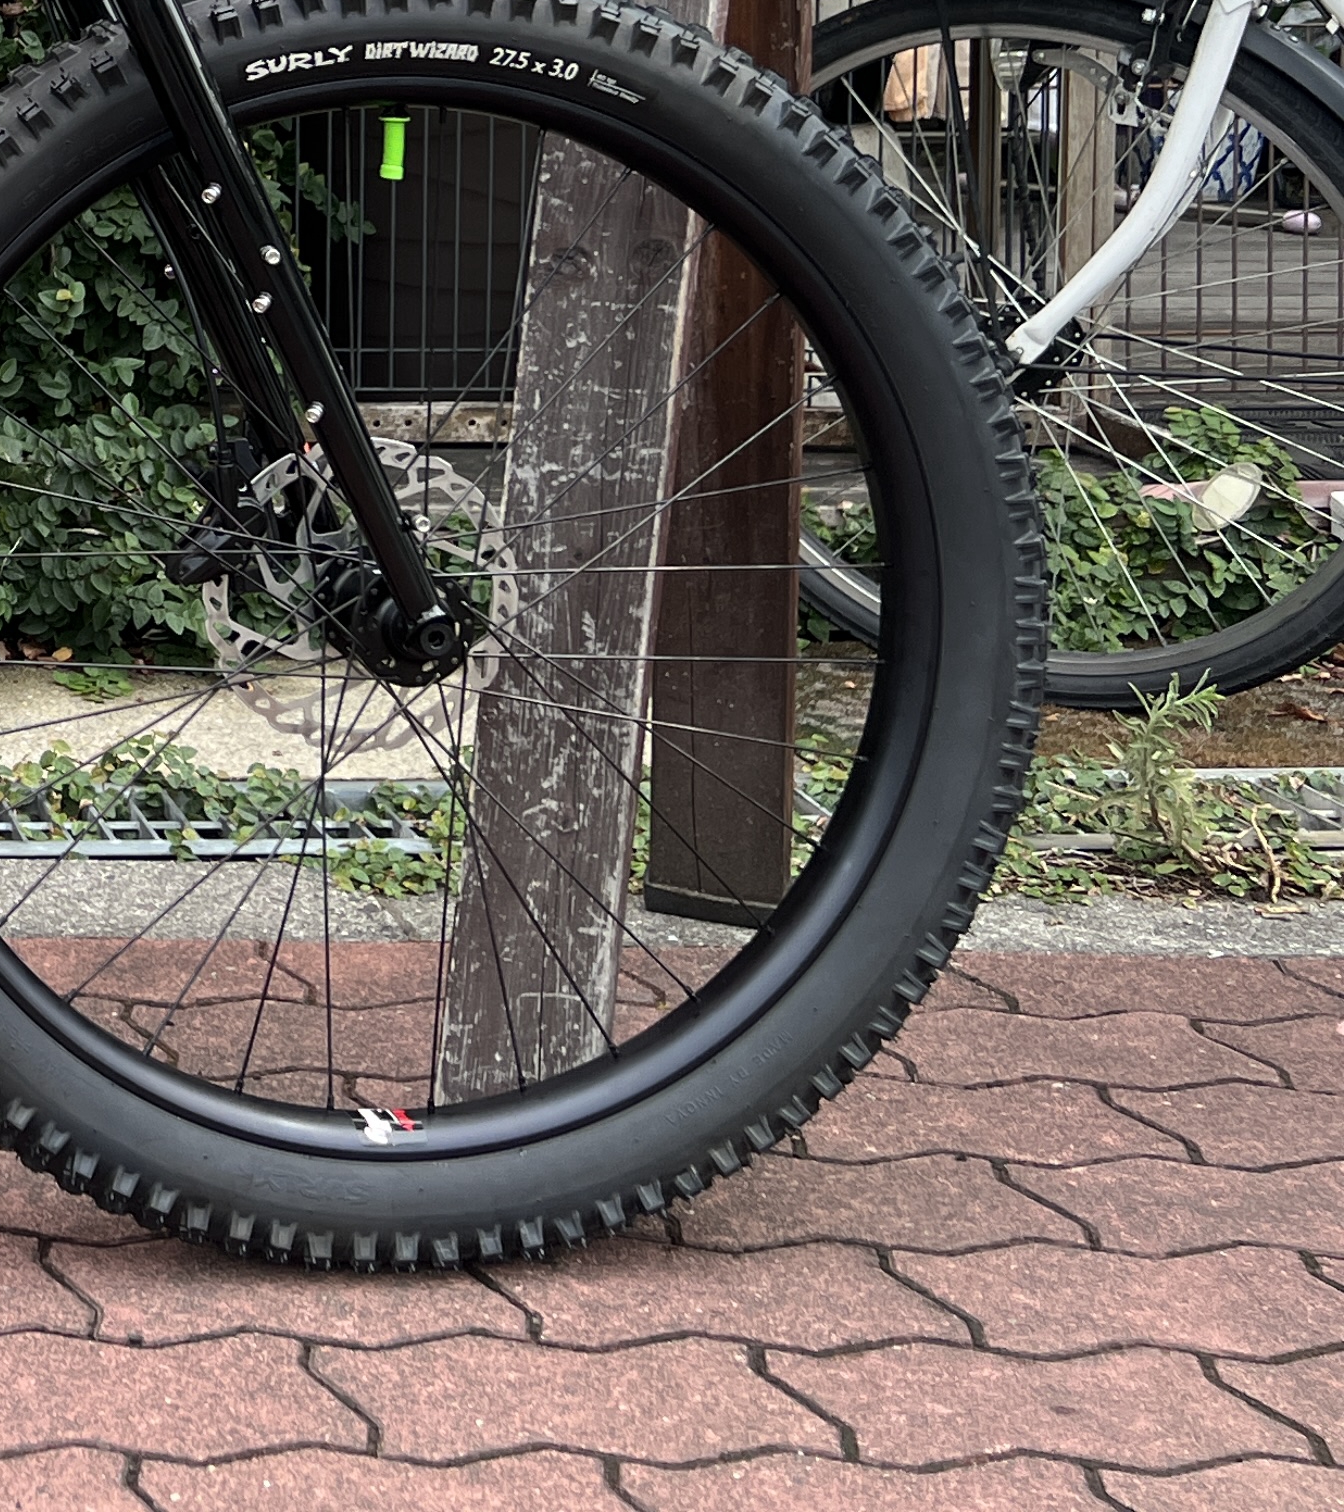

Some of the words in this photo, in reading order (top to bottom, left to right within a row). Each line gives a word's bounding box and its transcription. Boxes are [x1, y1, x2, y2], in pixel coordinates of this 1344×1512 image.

[245, 44, 353, 82] SURLY
[488, 47, 529, 72] 27.5
[548, 57, 579, 81] 3.0
